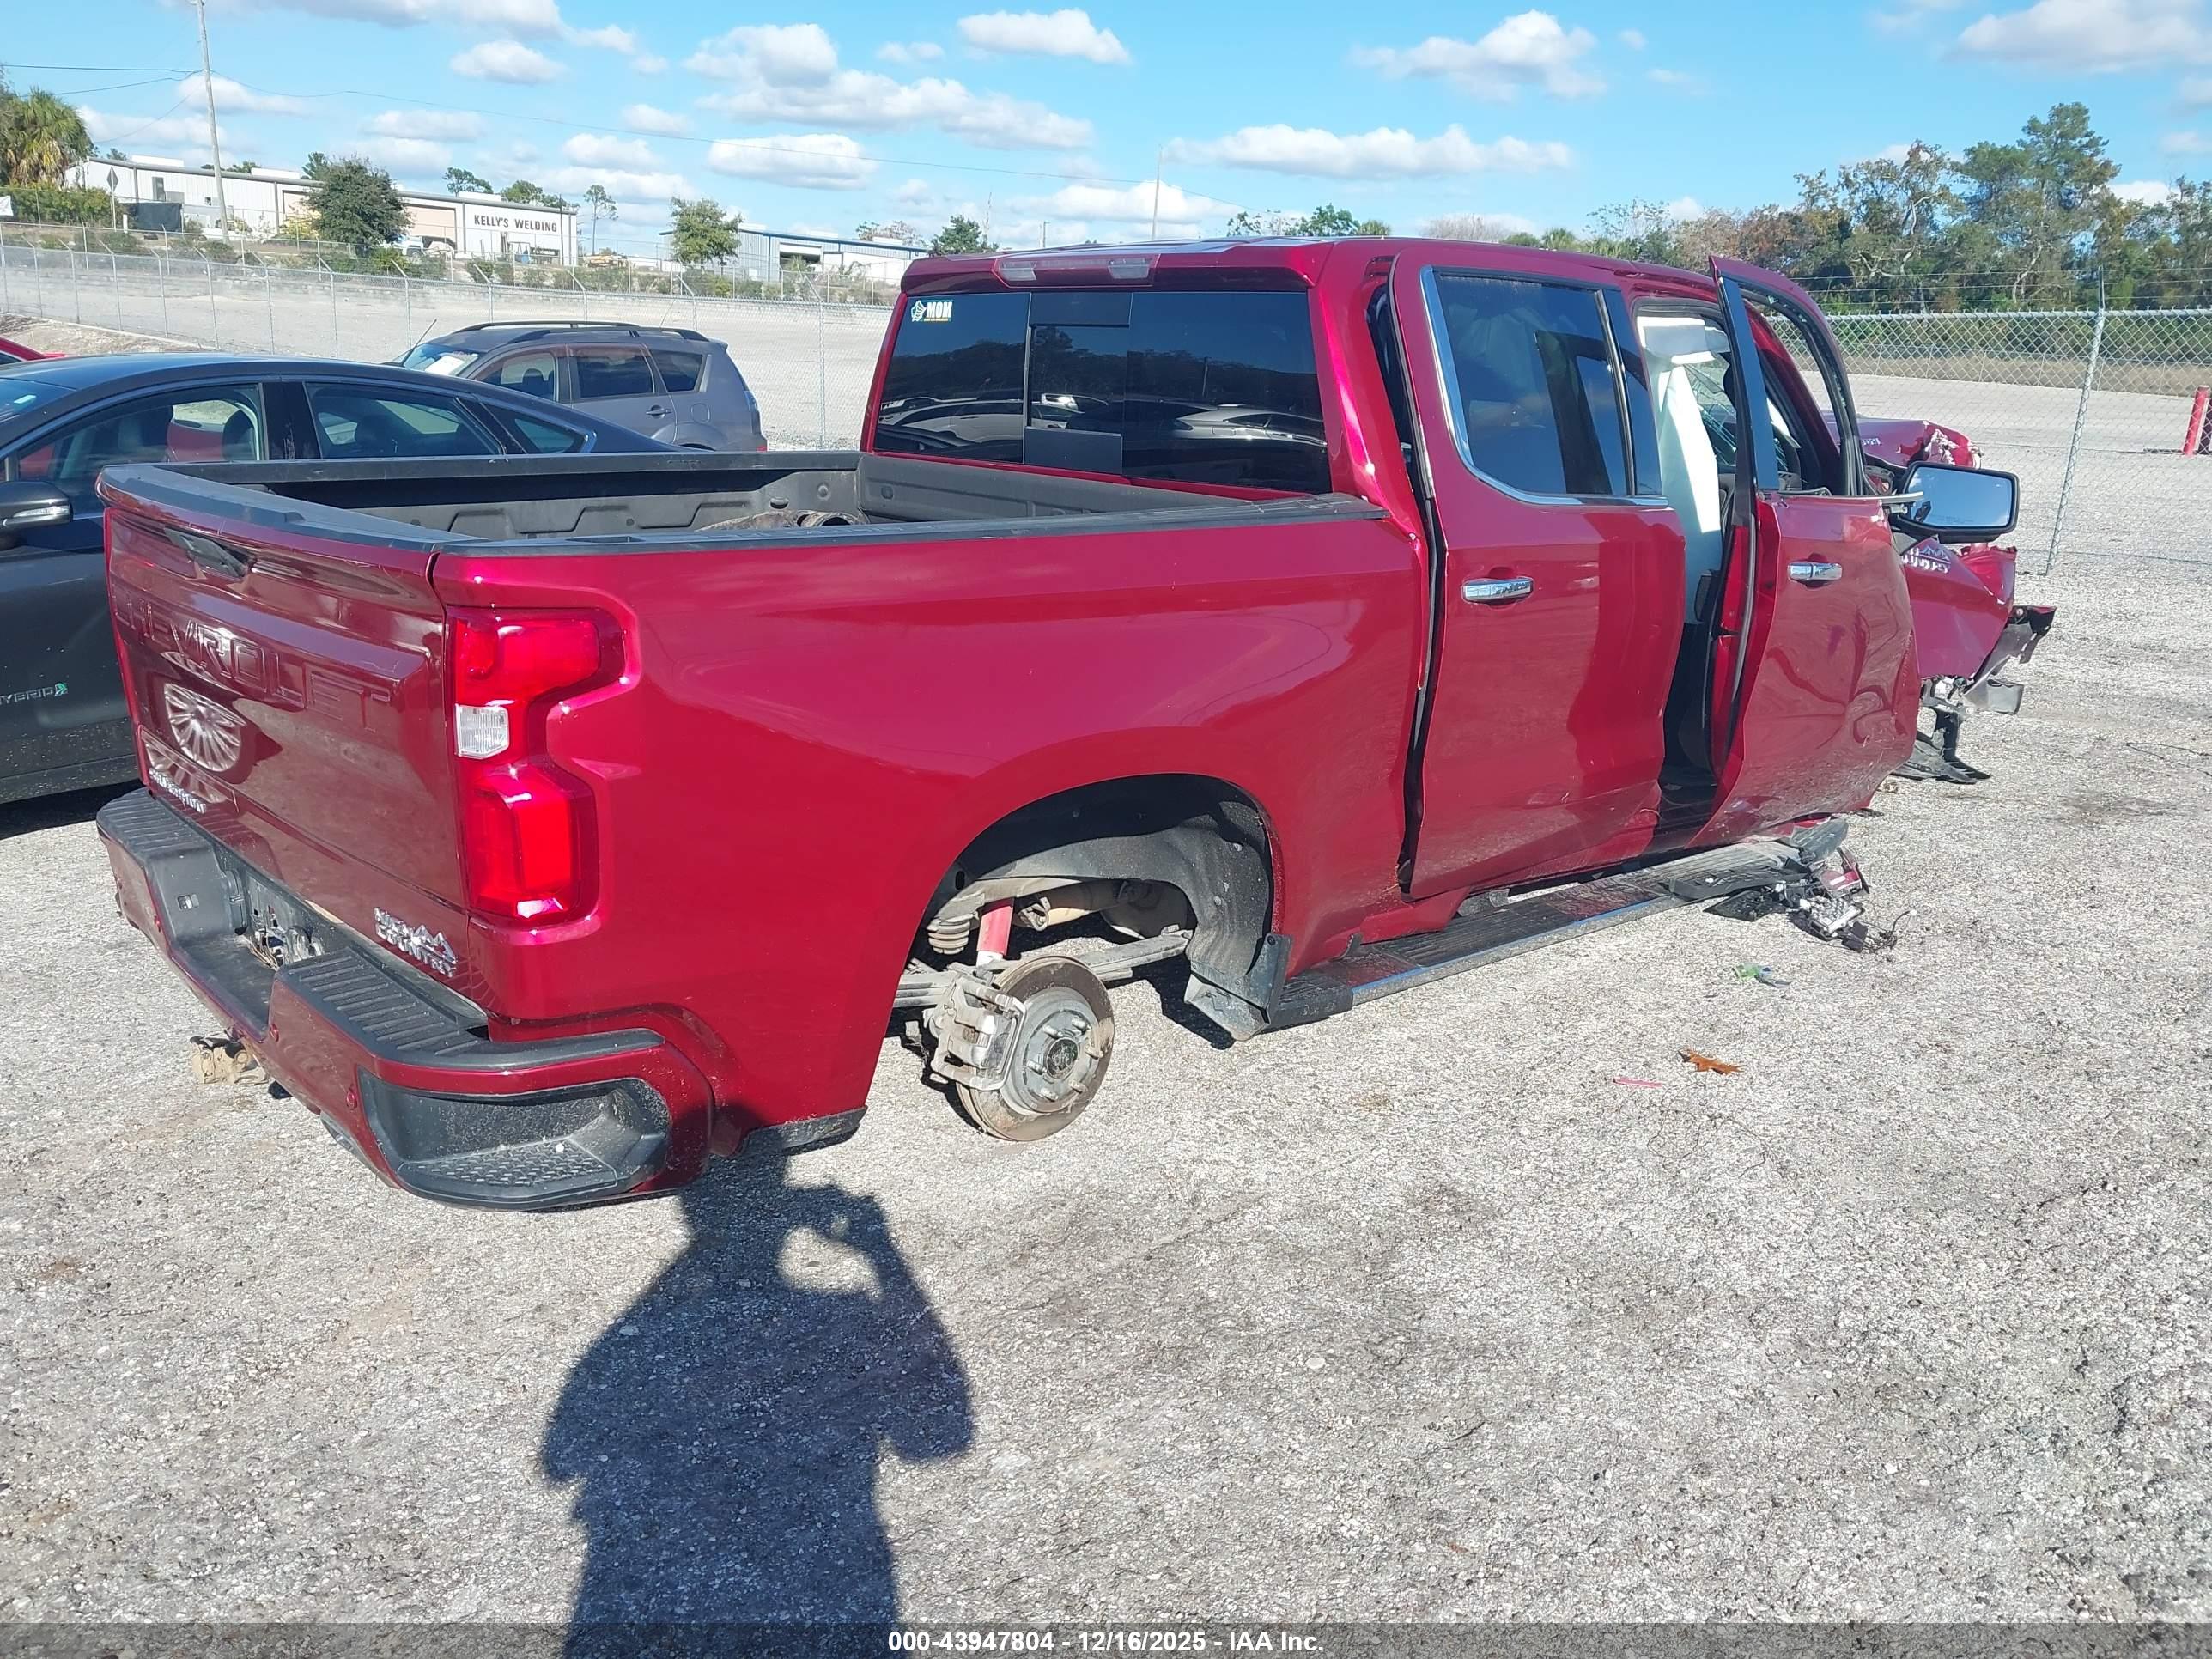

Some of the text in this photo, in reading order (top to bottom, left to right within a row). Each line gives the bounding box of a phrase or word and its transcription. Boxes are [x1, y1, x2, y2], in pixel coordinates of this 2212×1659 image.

[474, 215, 557, 232] KELLY'S WELDING
[926, 301, 953, 318] MOM
[114, 595, 391, 732] CHEVROLET
[0, 686, 54, 704] YBRID
